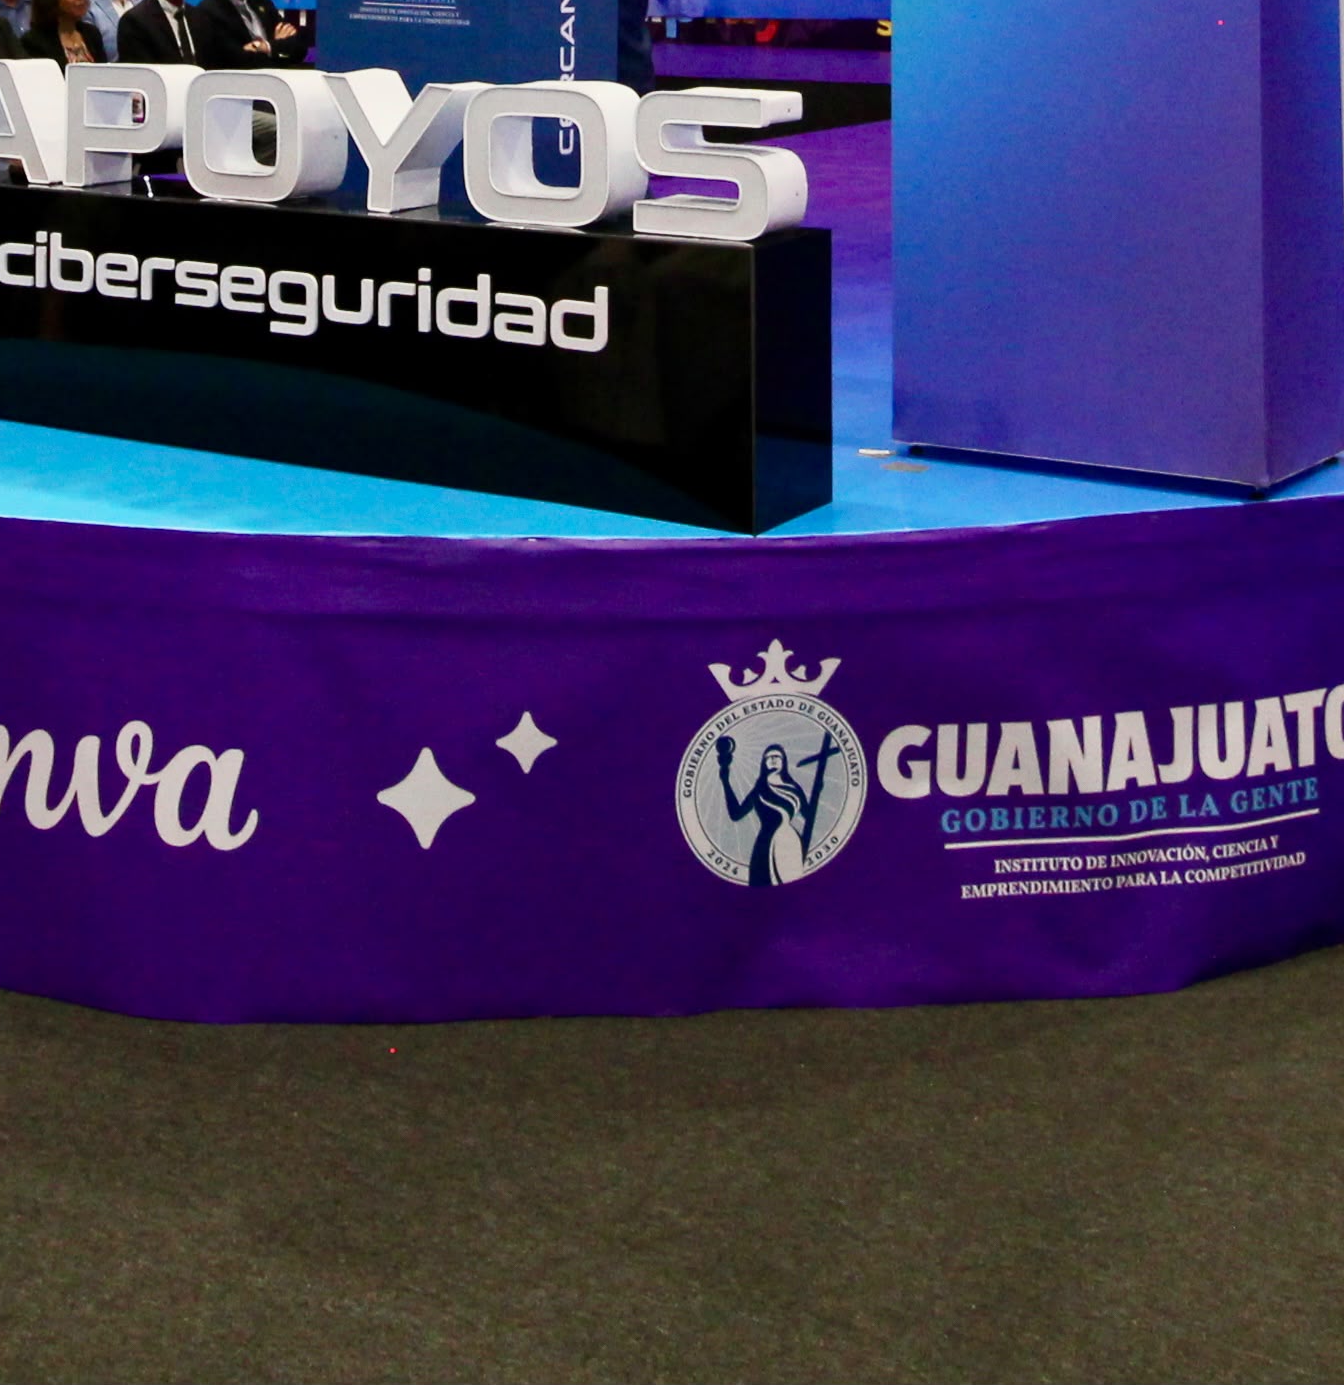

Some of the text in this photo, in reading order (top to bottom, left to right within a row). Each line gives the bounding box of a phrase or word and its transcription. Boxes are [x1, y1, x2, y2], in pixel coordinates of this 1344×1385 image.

[682, 699, 861, 799] GOBIERNO DEL ESTADO DE GUANAJUATO
[940, 777, 1321, 835] GOBIERNO DE LA GENTE
[705, 835, 840, 877] 2024 2030
[960, 850, 1306, 900] EMPRENDIMIENTO PARA LA COMPETITIVIDAD
[994, 834, 1279, 875] INSTITUTO DE INNOVACIÓN, CIENCIA Y
